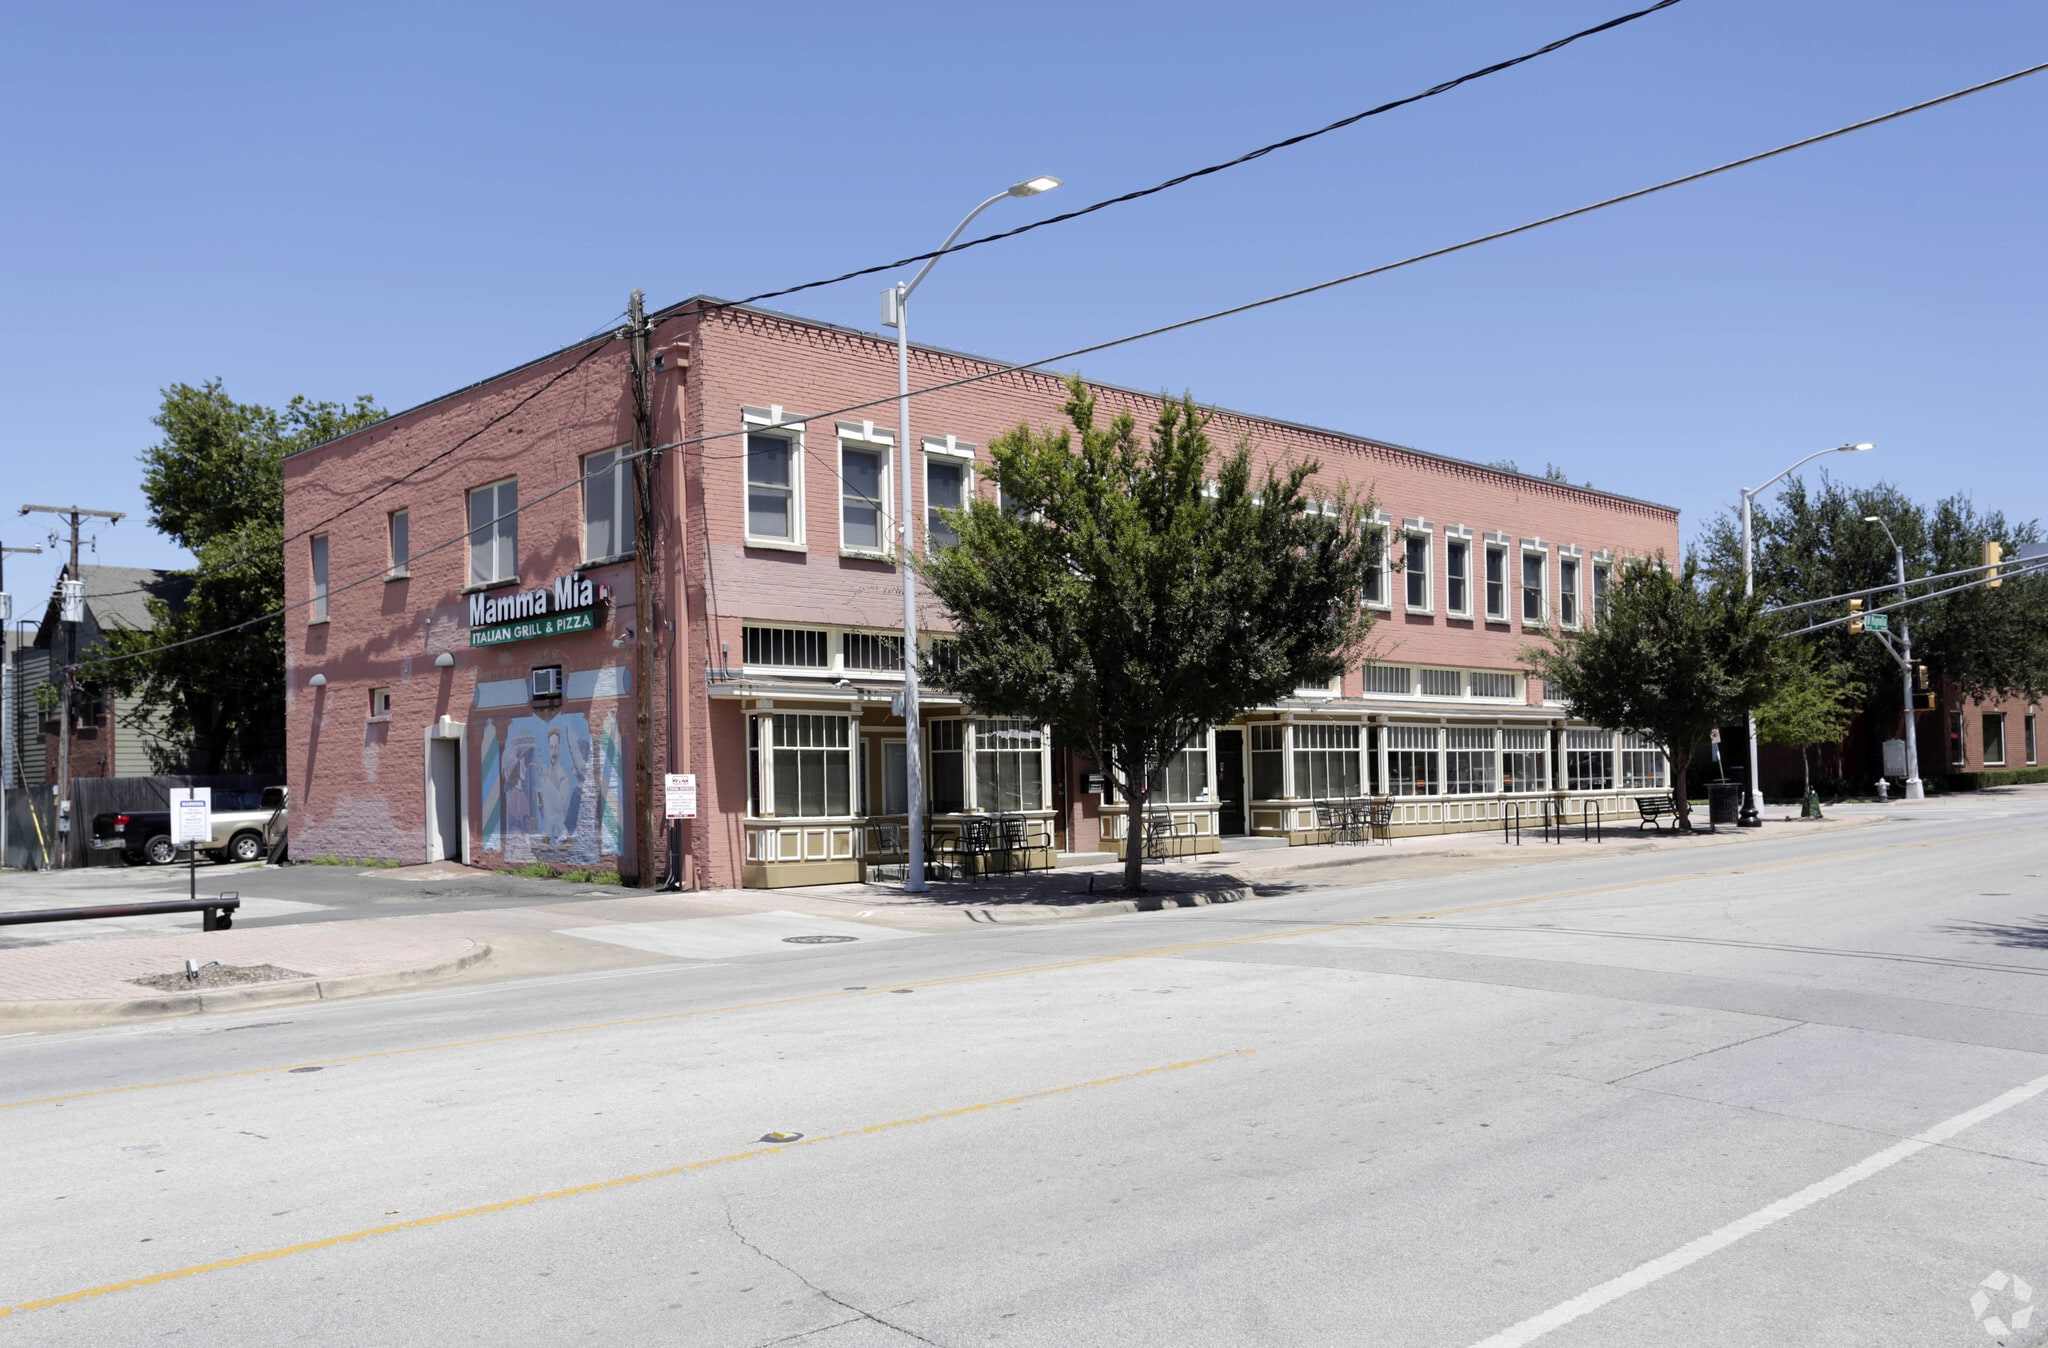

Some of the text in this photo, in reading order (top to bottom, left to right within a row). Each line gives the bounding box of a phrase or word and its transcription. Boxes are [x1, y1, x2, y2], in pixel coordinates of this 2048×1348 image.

[469, 571, 593, 626] Mamma Mia
[472, 614, 592, 644] ITALIAN GRILL & PIZZA
